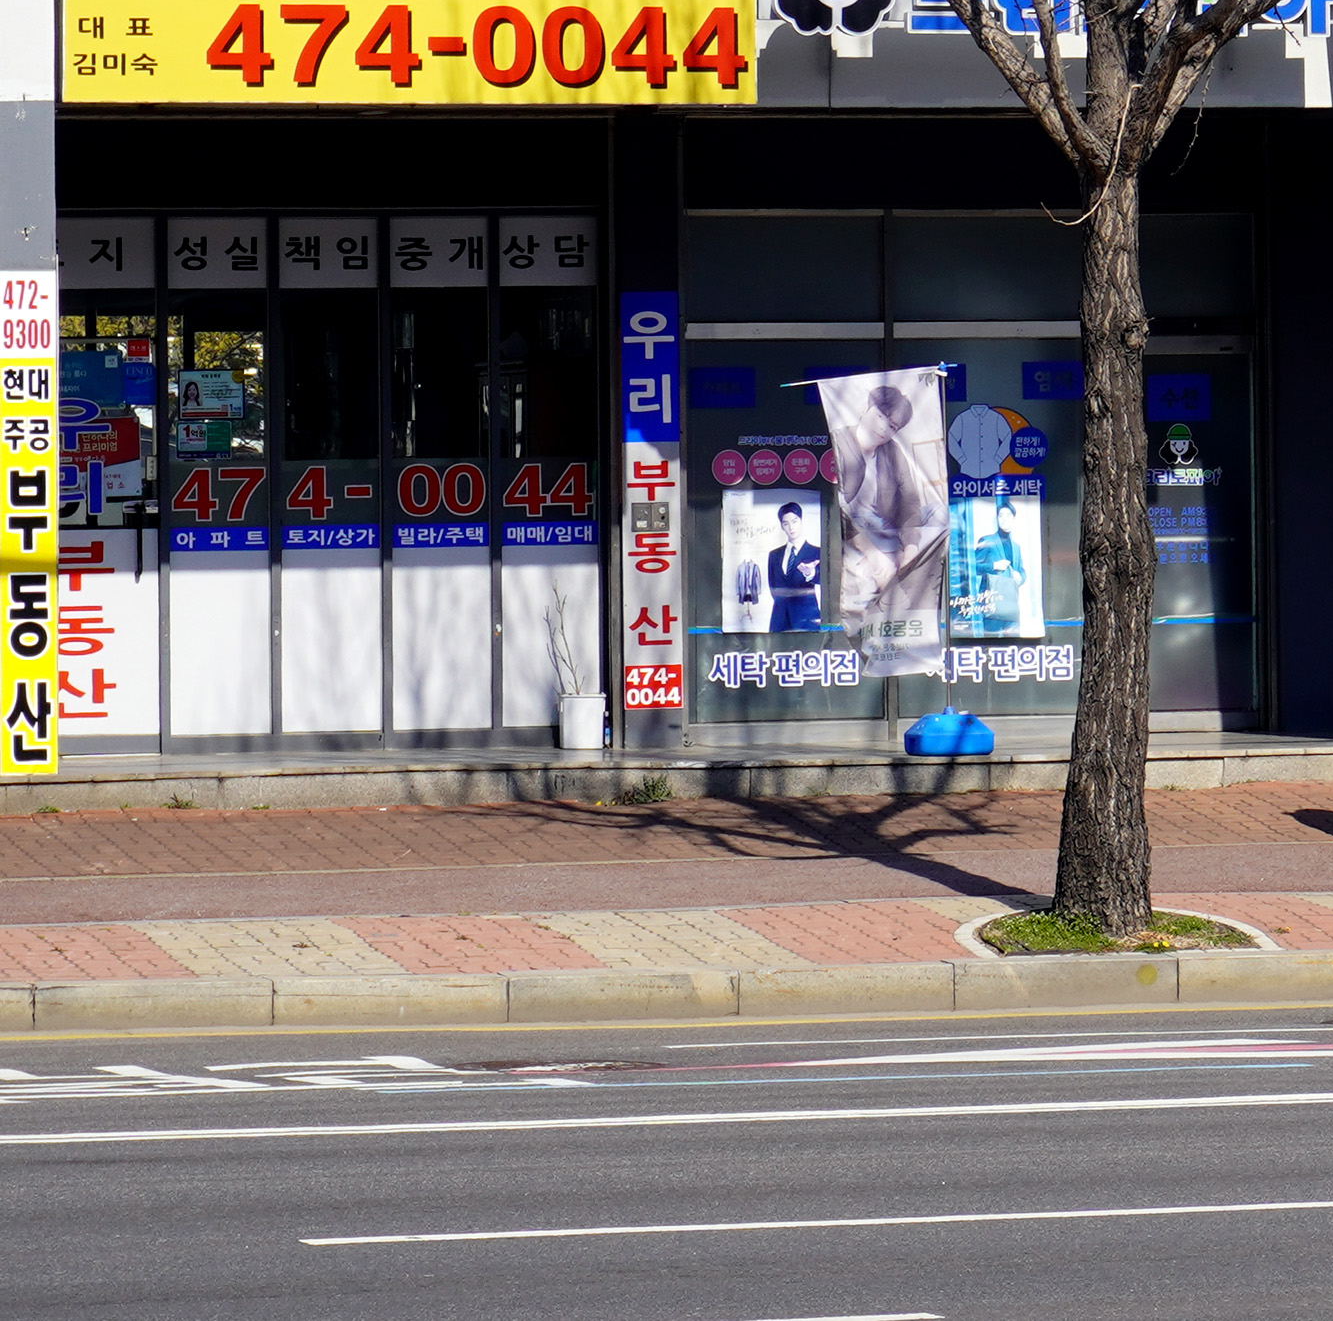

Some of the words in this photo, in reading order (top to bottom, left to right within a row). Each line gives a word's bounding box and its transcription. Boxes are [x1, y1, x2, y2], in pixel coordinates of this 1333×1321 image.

[78, 15, 153, 39] 대표
[206, 3, 748, 88] 474-0044
[73, 52, 158, 77] 김미숙
[174, 235, 260, 271] 성실
[284, 235, 370, 271] 책임
[395, 235, 485, 271] 중개
[502, 234, 590, 270] 상담
[2, 280, 49, 310] 472-
[3, 319, 51, 350] 9300
[623, 311, 675, 424] 우리
[2, 368, 50, 401] 현대
[3, 418, 50, 451] 주공
[952, 479, 1011, 497] 와이셔츠
[1014, 478, 1042, 496] 세탁
[1148, 507, 1172, 516] OPEN
[176, 530, 265, 548] 아파트
[286, 529, 375, 547] 토지/상가
[398, 527, 485, 546] 빌라/주택
[506, 525, 593, 543] 매매/임대
[626, 460, 677, 646] 부동산
[6, 469, 52, 764] 부동산
[58, 540, 116, 718] 부동산
[626, 667, 676, 686] 474-
[709, 651, 769, 688] 세탁
[773, 649, 861, 687] 편의점
[988, 645, 1076, 683] 편의점
[626, 688, 680, 706] 0044
